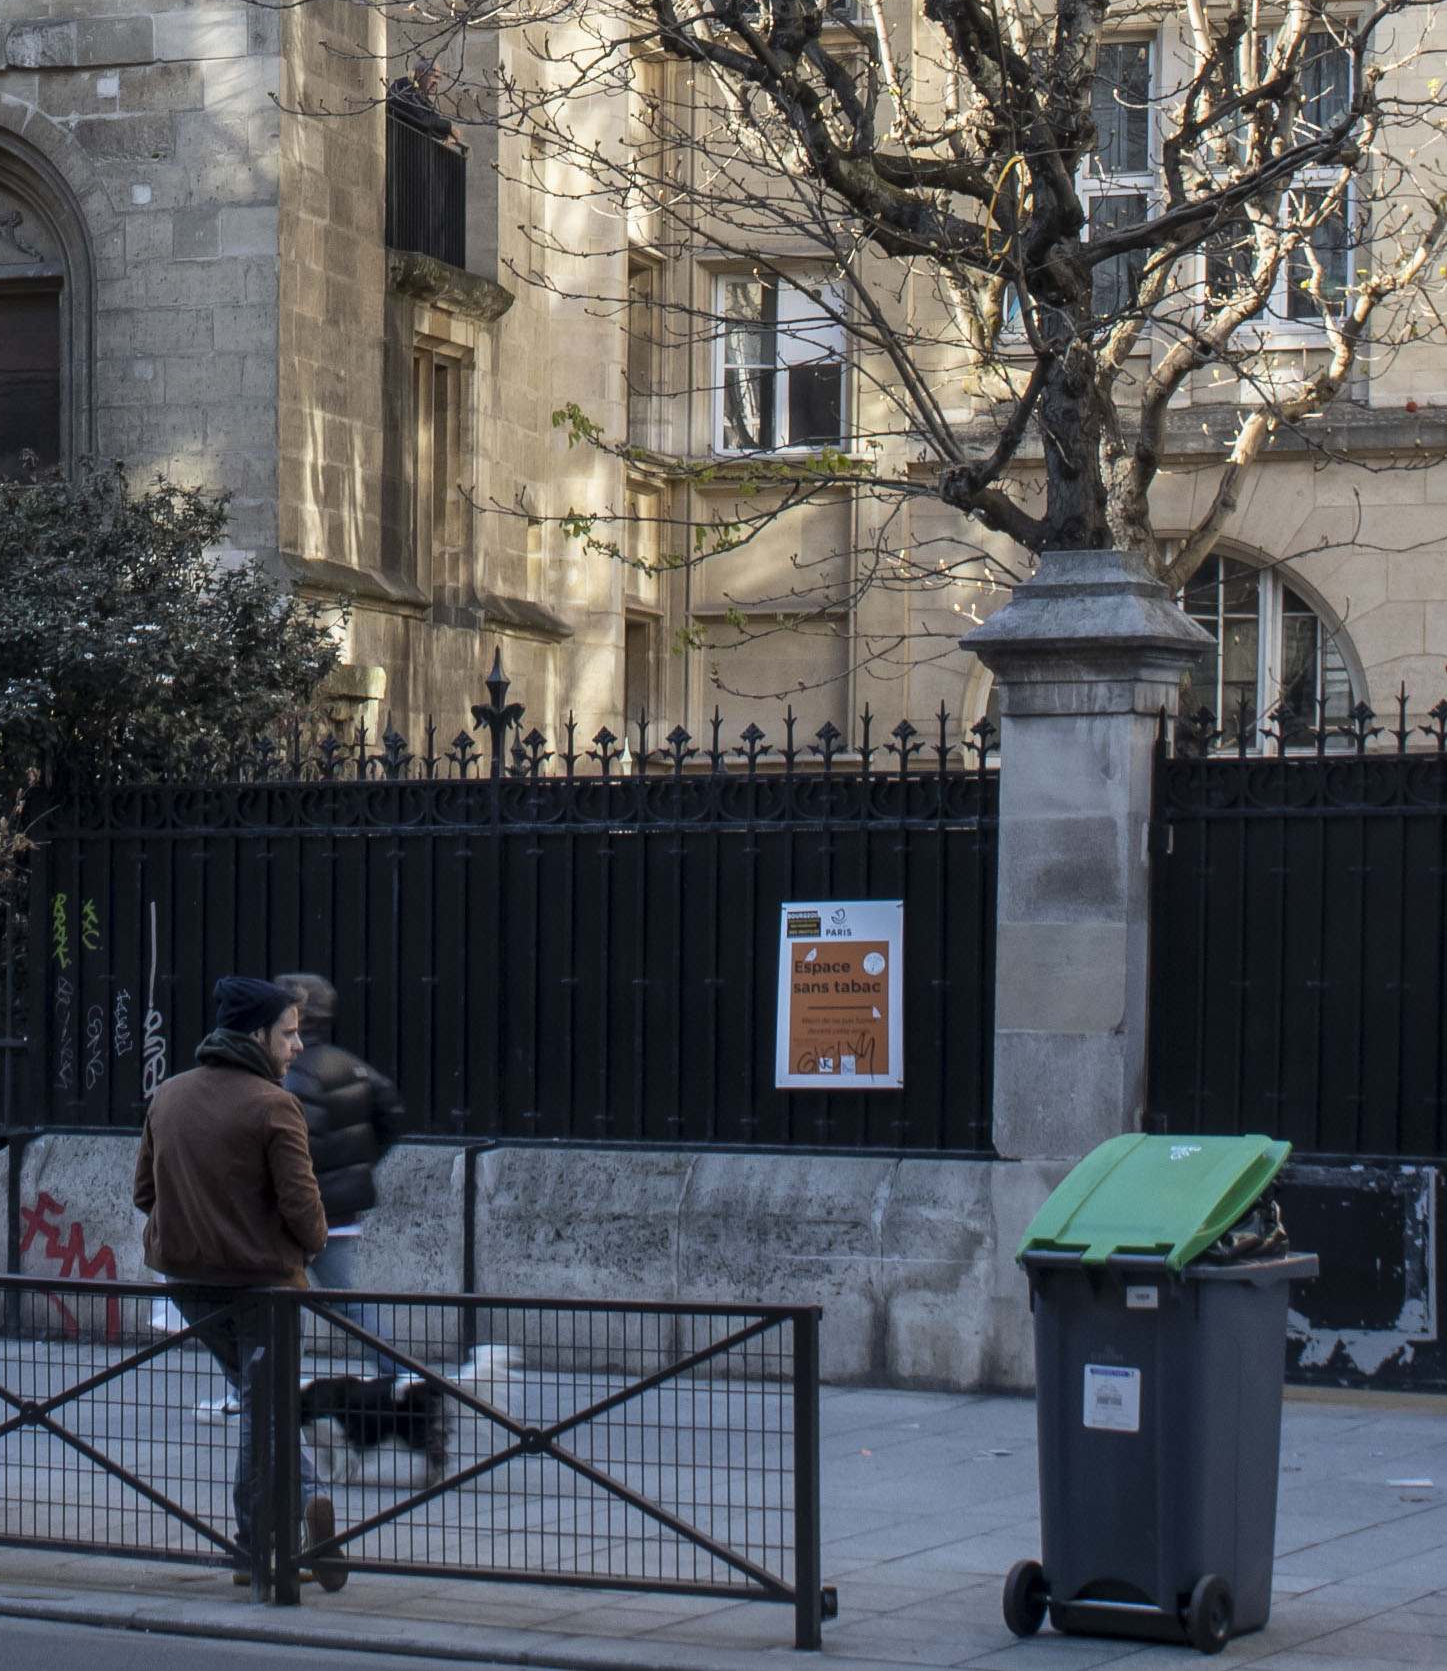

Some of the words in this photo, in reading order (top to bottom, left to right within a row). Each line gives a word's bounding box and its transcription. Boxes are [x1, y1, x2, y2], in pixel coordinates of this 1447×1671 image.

[826, 928, 852, 937] PARIS
[794, 960, 851, 976] Espace
[793, 982, 830, 994] sans
[834, 979, 881, 994] tabac
